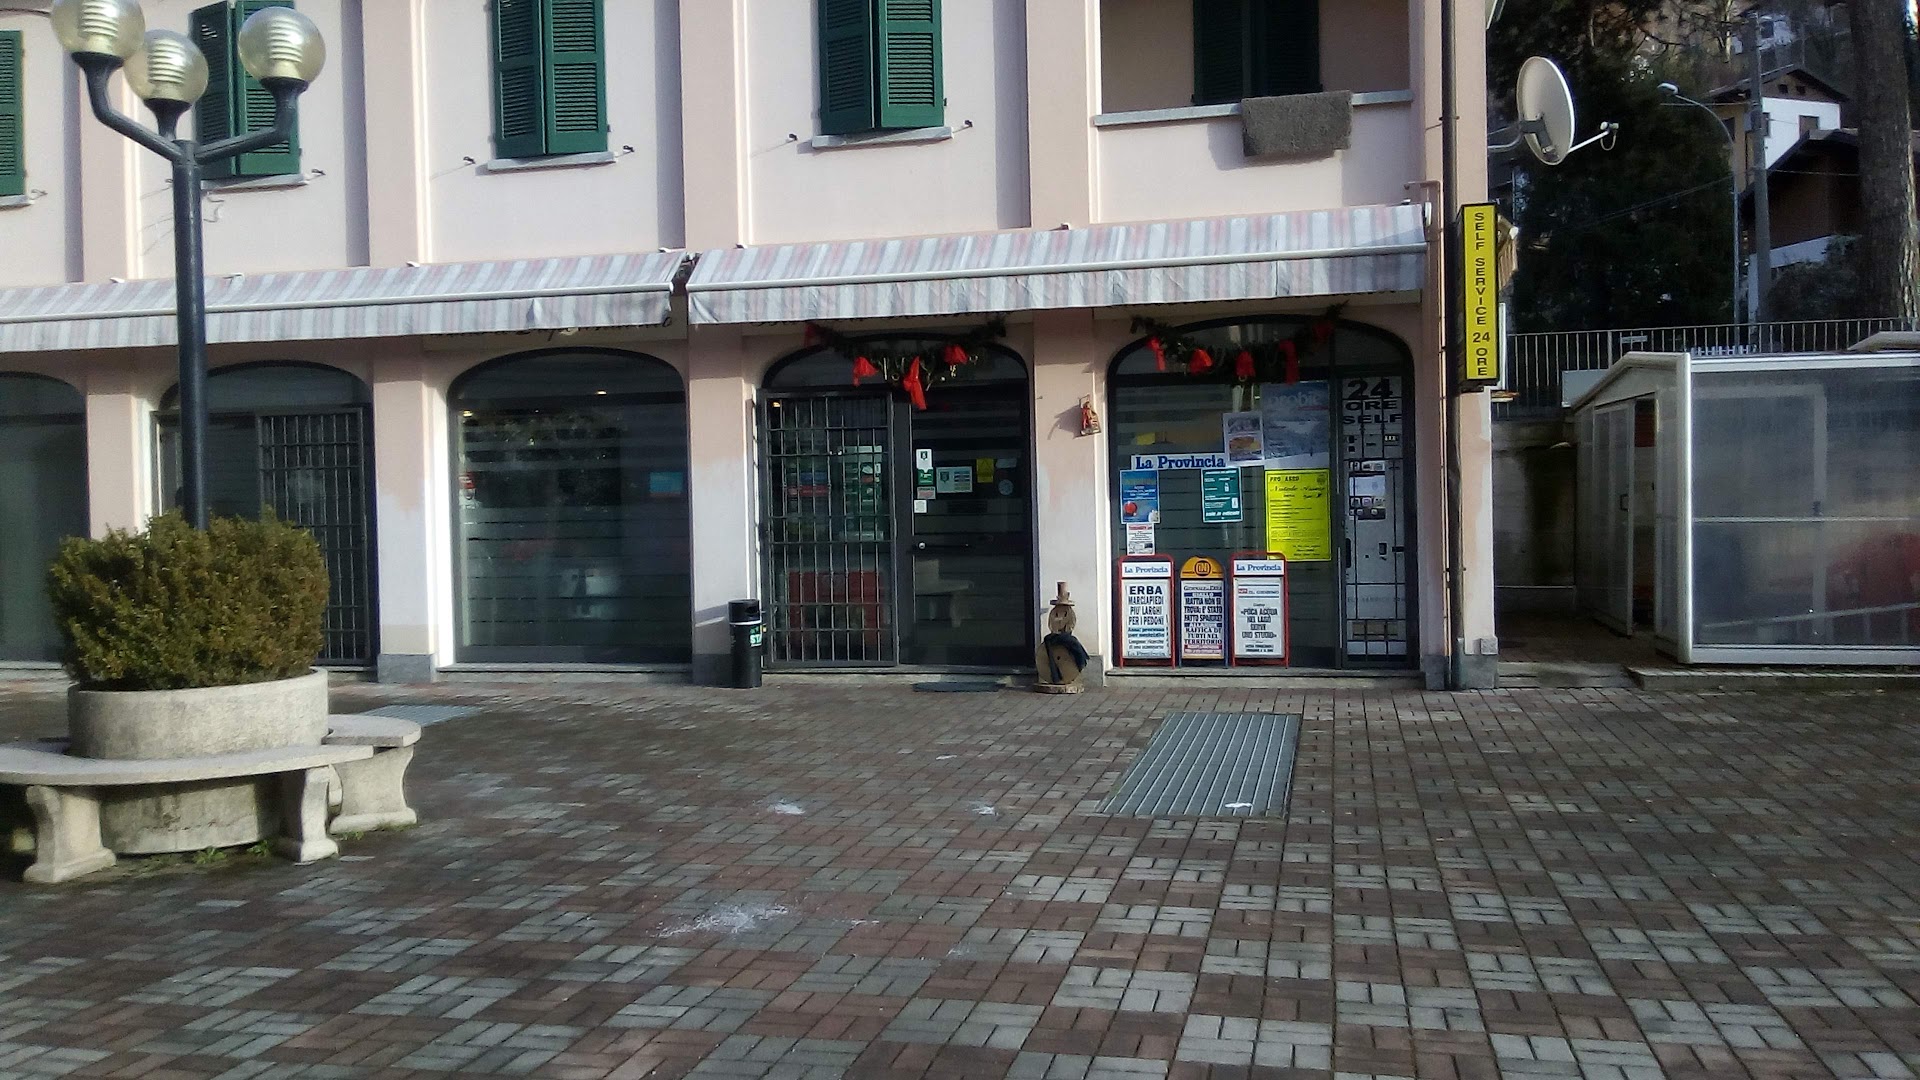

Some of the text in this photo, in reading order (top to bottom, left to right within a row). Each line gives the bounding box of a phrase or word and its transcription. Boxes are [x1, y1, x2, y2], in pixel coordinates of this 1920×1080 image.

[1472, 212, 1491, 376] SELF SERVICE 24 ORE
[1347, 378, 1394, 399] 24
[1345, 400, 1398, 411] ORE
[1343, 414, 1402, 425] SELF
[1136, 455, 1226, 470] La Provincia
[1236, 563, 1282, 571] La Provincia
[1129, 585, 1163, 595] ERBA
[1128, 595, 1164, 605] MARCIAPIEDI
[1142, 605, 1162, 615] LARGHI
[1259, 608, 1278, 616] ACQUA
[1128, 616, 1139, 625] PER
[1143, 616, 1164, 625] PEDONI
